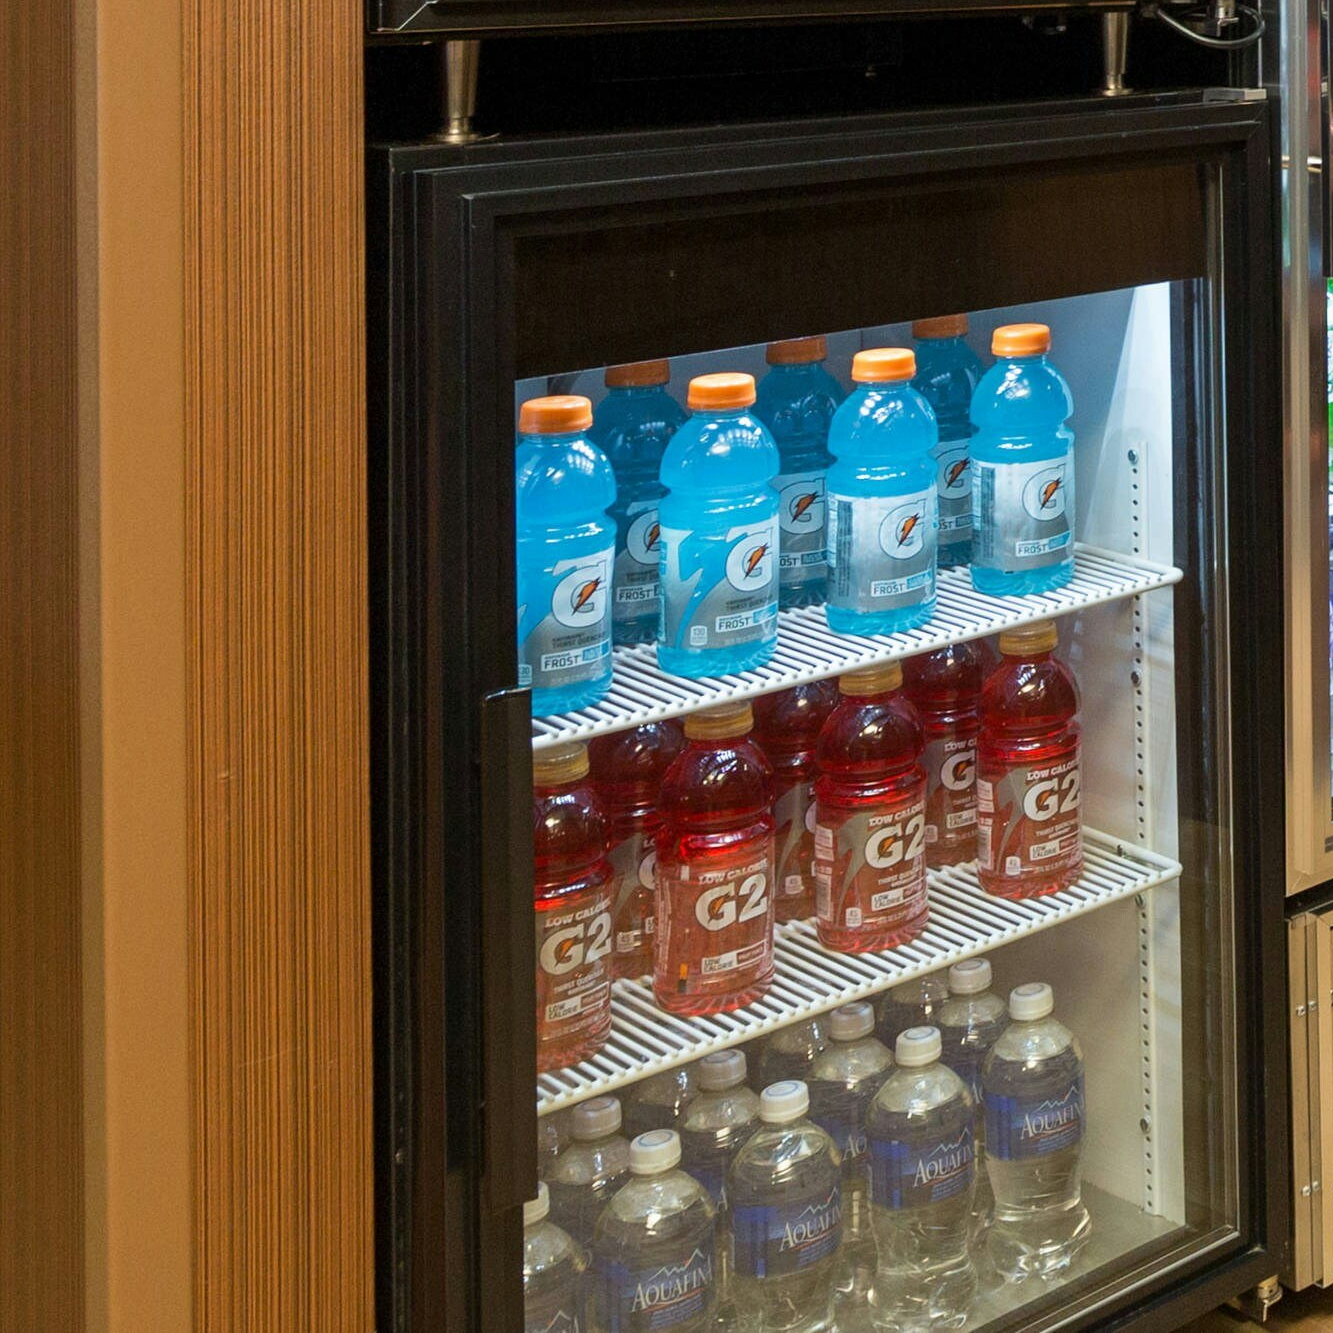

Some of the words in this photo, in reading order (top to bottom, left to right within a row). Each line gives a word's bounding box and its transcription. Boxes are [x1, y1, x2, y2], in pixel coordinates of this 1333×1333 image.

[1018, 544, 1048, 556] FROST
[619, 588, 650, 601] FROST
[873, 583, 906, 595] FROST
[719, 618, 751, 632] FROST
[544, 656, 580, 670] FROST
[1027, 769, 1050, 781] LOW
[1023, 770, 1080, 821] G2
[869, 814, 893, 826] LOW
[865, 813, 925, 868] G2
[700, 870, 726, 884] LOW
[695, 873, 768, 931] G2
[546, 915, 574, 928] LOW
[539, 912, 612, 975] G2
[1020, 1103, 1085, 1140] AQUAFIN
[913, 1144, 973, 1188] AQUAFIN
[780, 1205, 842, 1252] AQUAFIN
[631, 1254, 714, 1313] AQUAFIN
